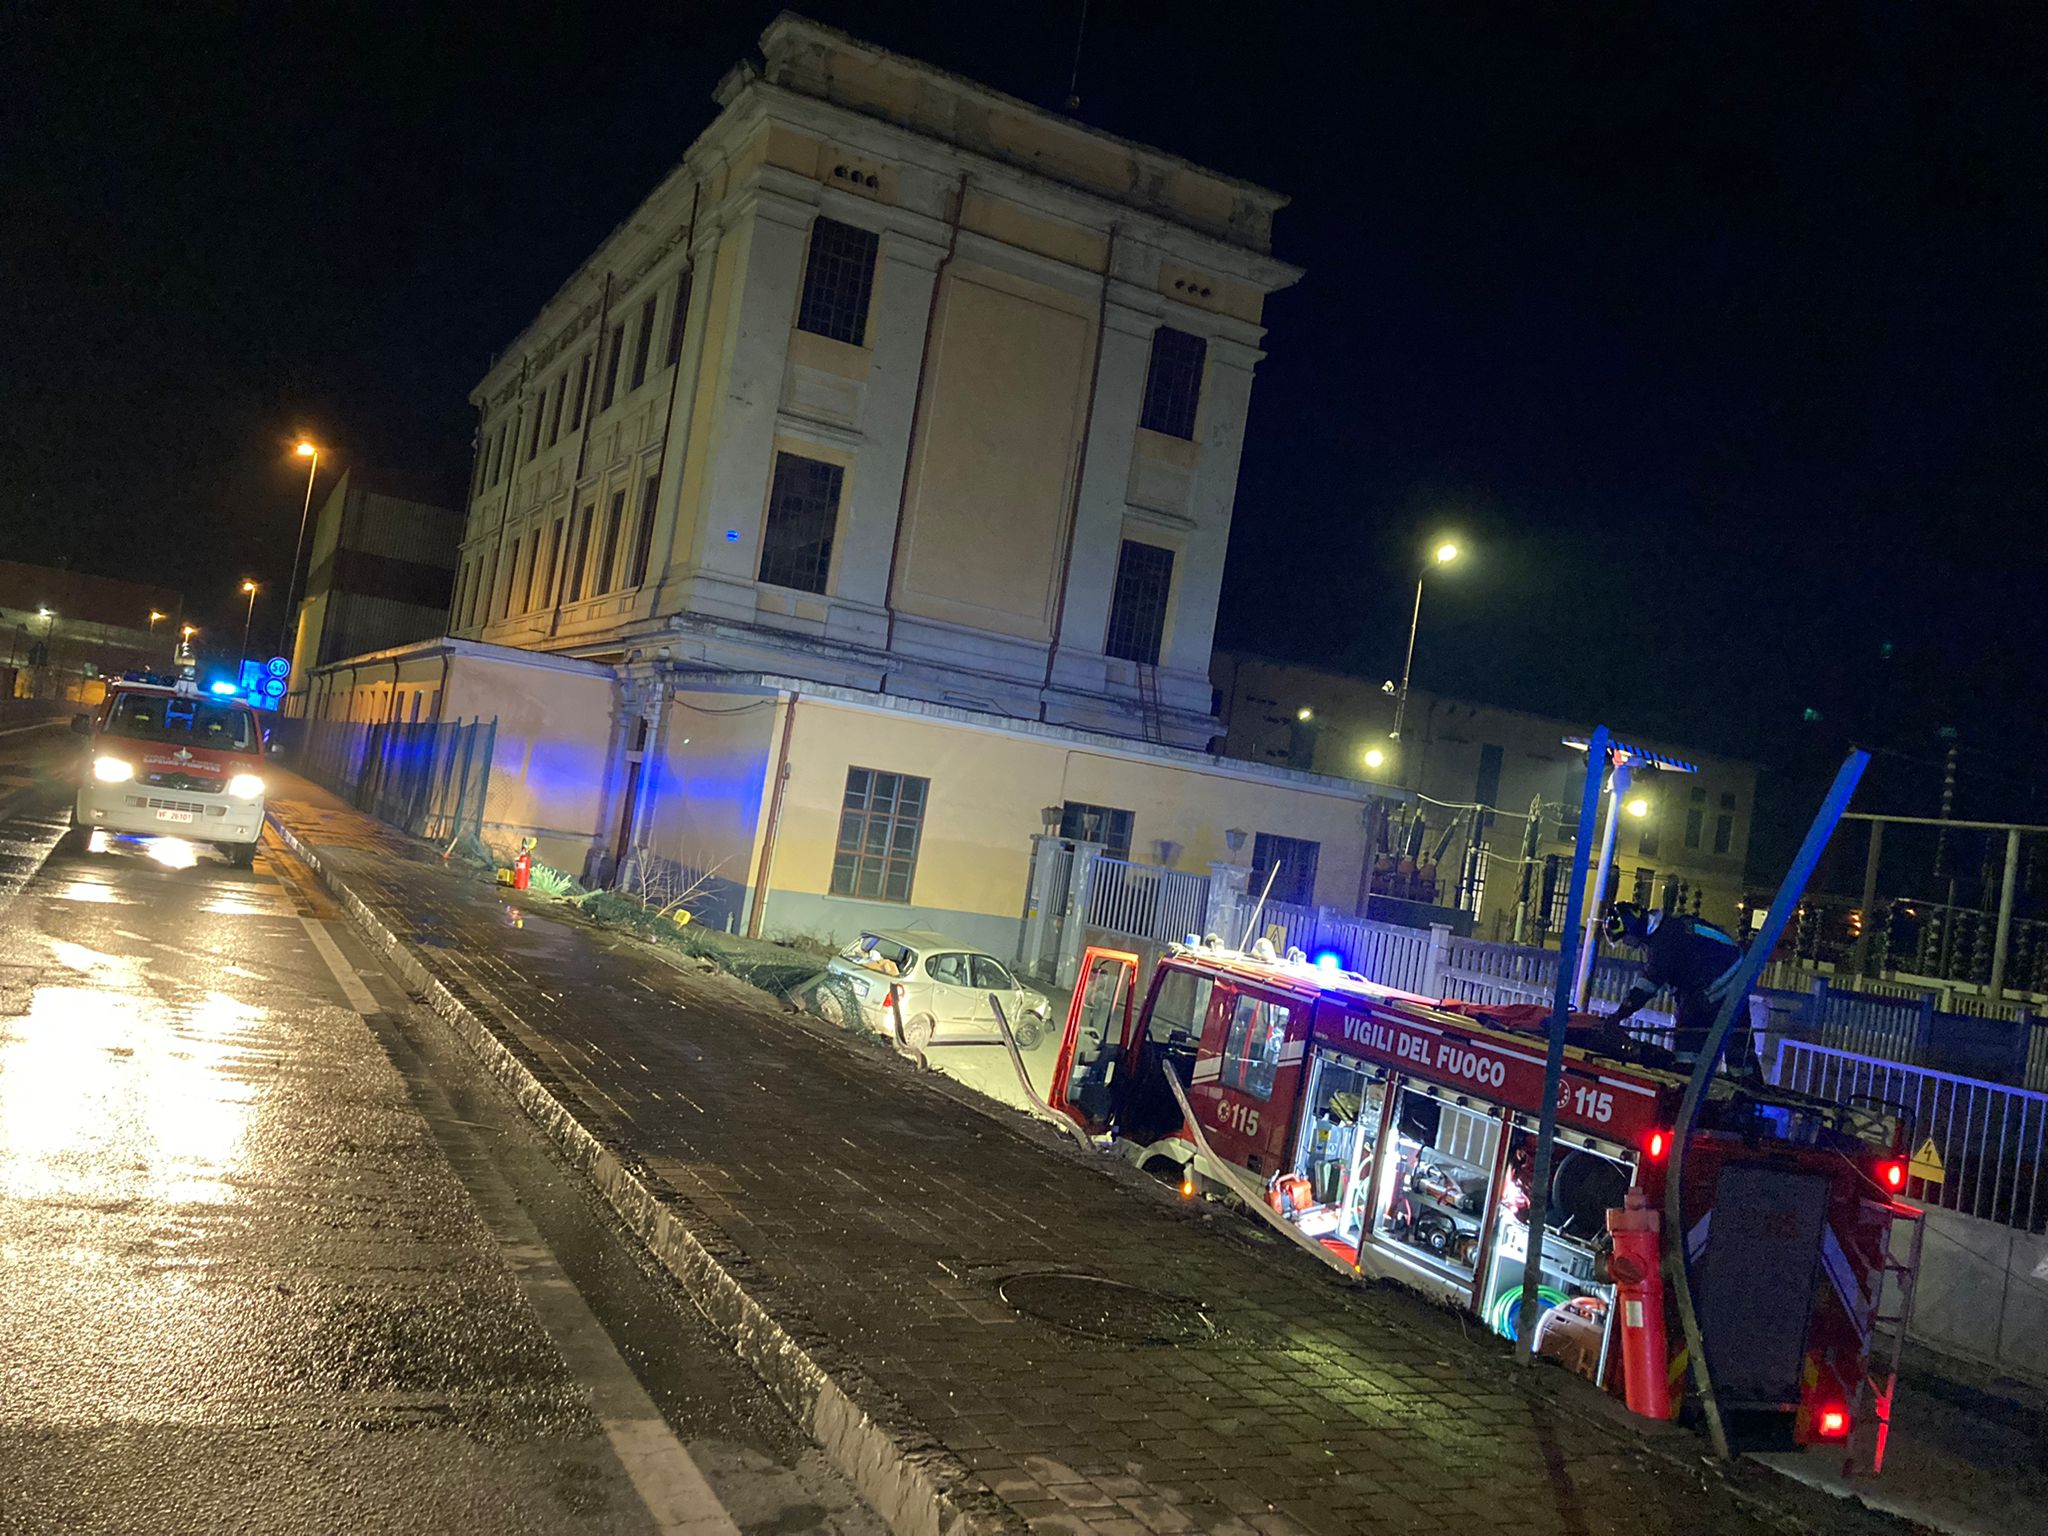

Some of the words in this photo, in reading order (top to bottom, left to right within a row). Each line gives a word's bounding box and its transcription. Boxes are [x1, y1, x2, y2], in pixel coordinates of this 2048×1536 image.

[271, 661, 286, 674] 50
[1344, 1015, 1394, 1052] VIGILI
[1397, 1032, 1431, 1065] DEL
[1436, 1044, 1506, 1088] FUOCO
[1231, 1103, 1259, 1137] 115
[1575, 1086, 1613, 1123] 115
